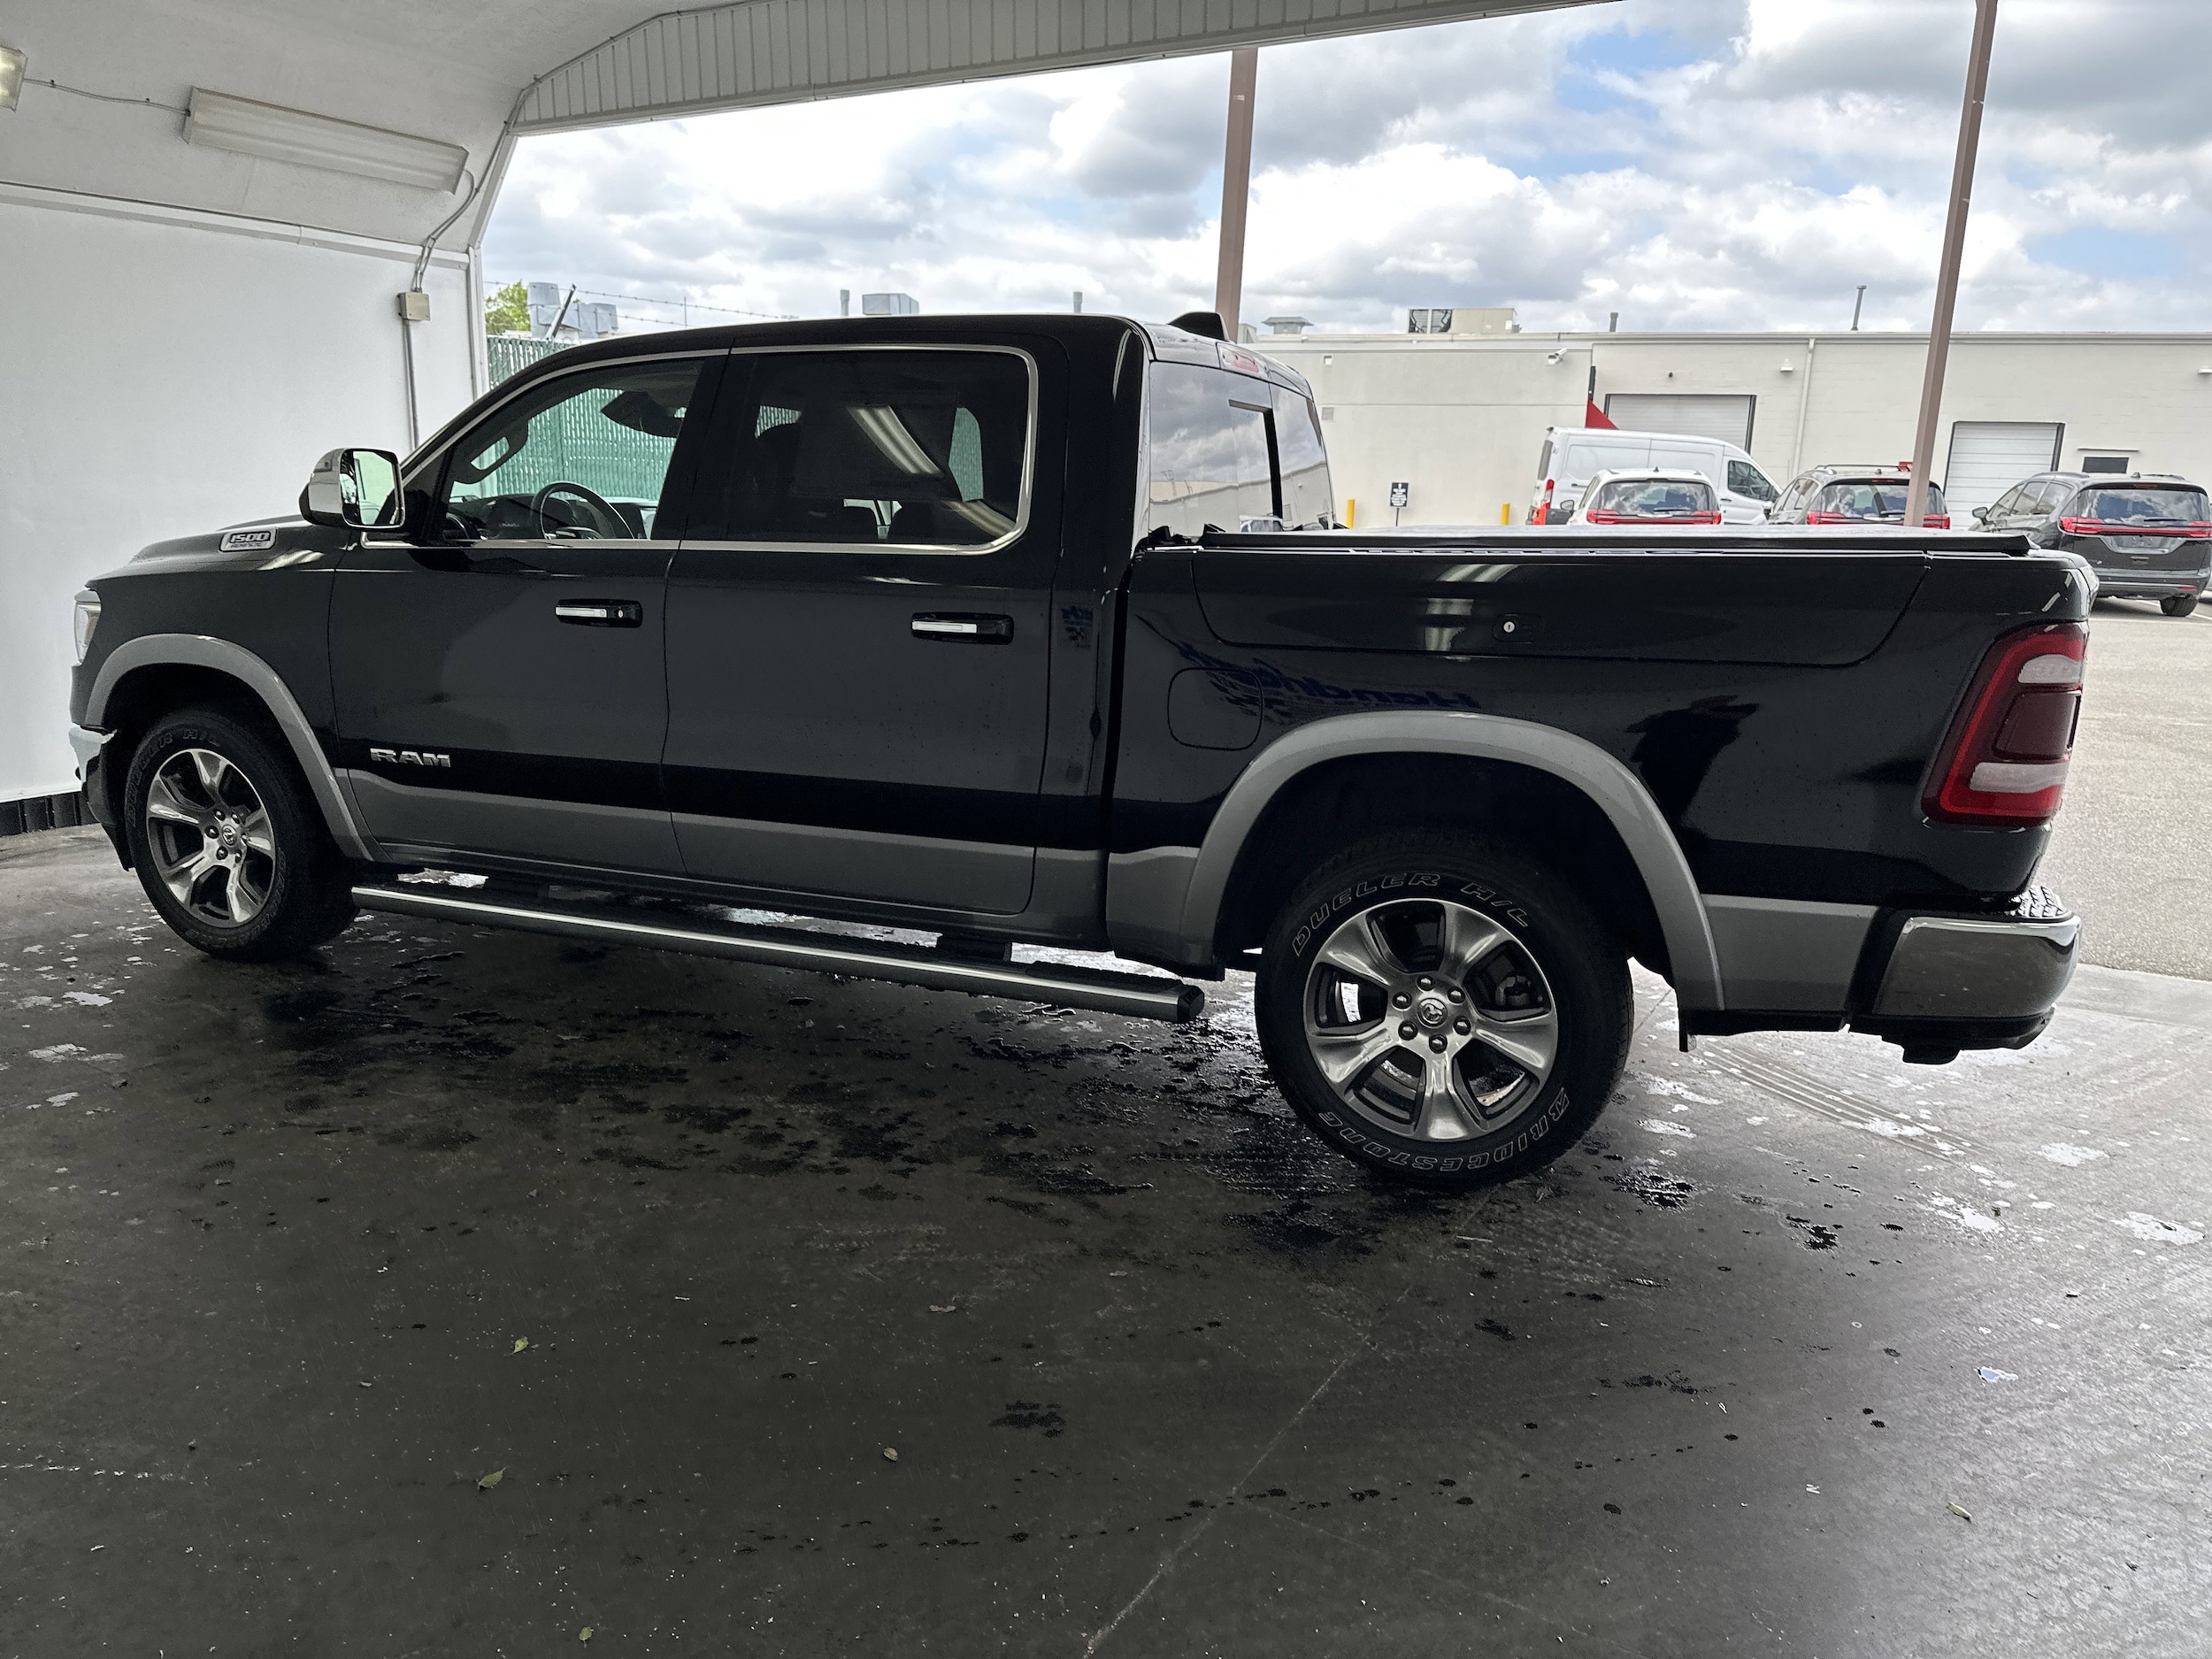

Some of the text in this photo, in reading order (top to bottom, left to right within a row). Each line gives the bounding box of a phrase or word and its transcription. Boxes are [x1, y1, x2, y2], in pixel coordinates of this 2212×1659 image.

[230, 532, 271, 543] 1500
[370, 747, 452, 768] RAM
[1291, 872, 1529, 957] DUELER H/L
[1317, 1087, 1571, 1172] BRIDGESTONE
